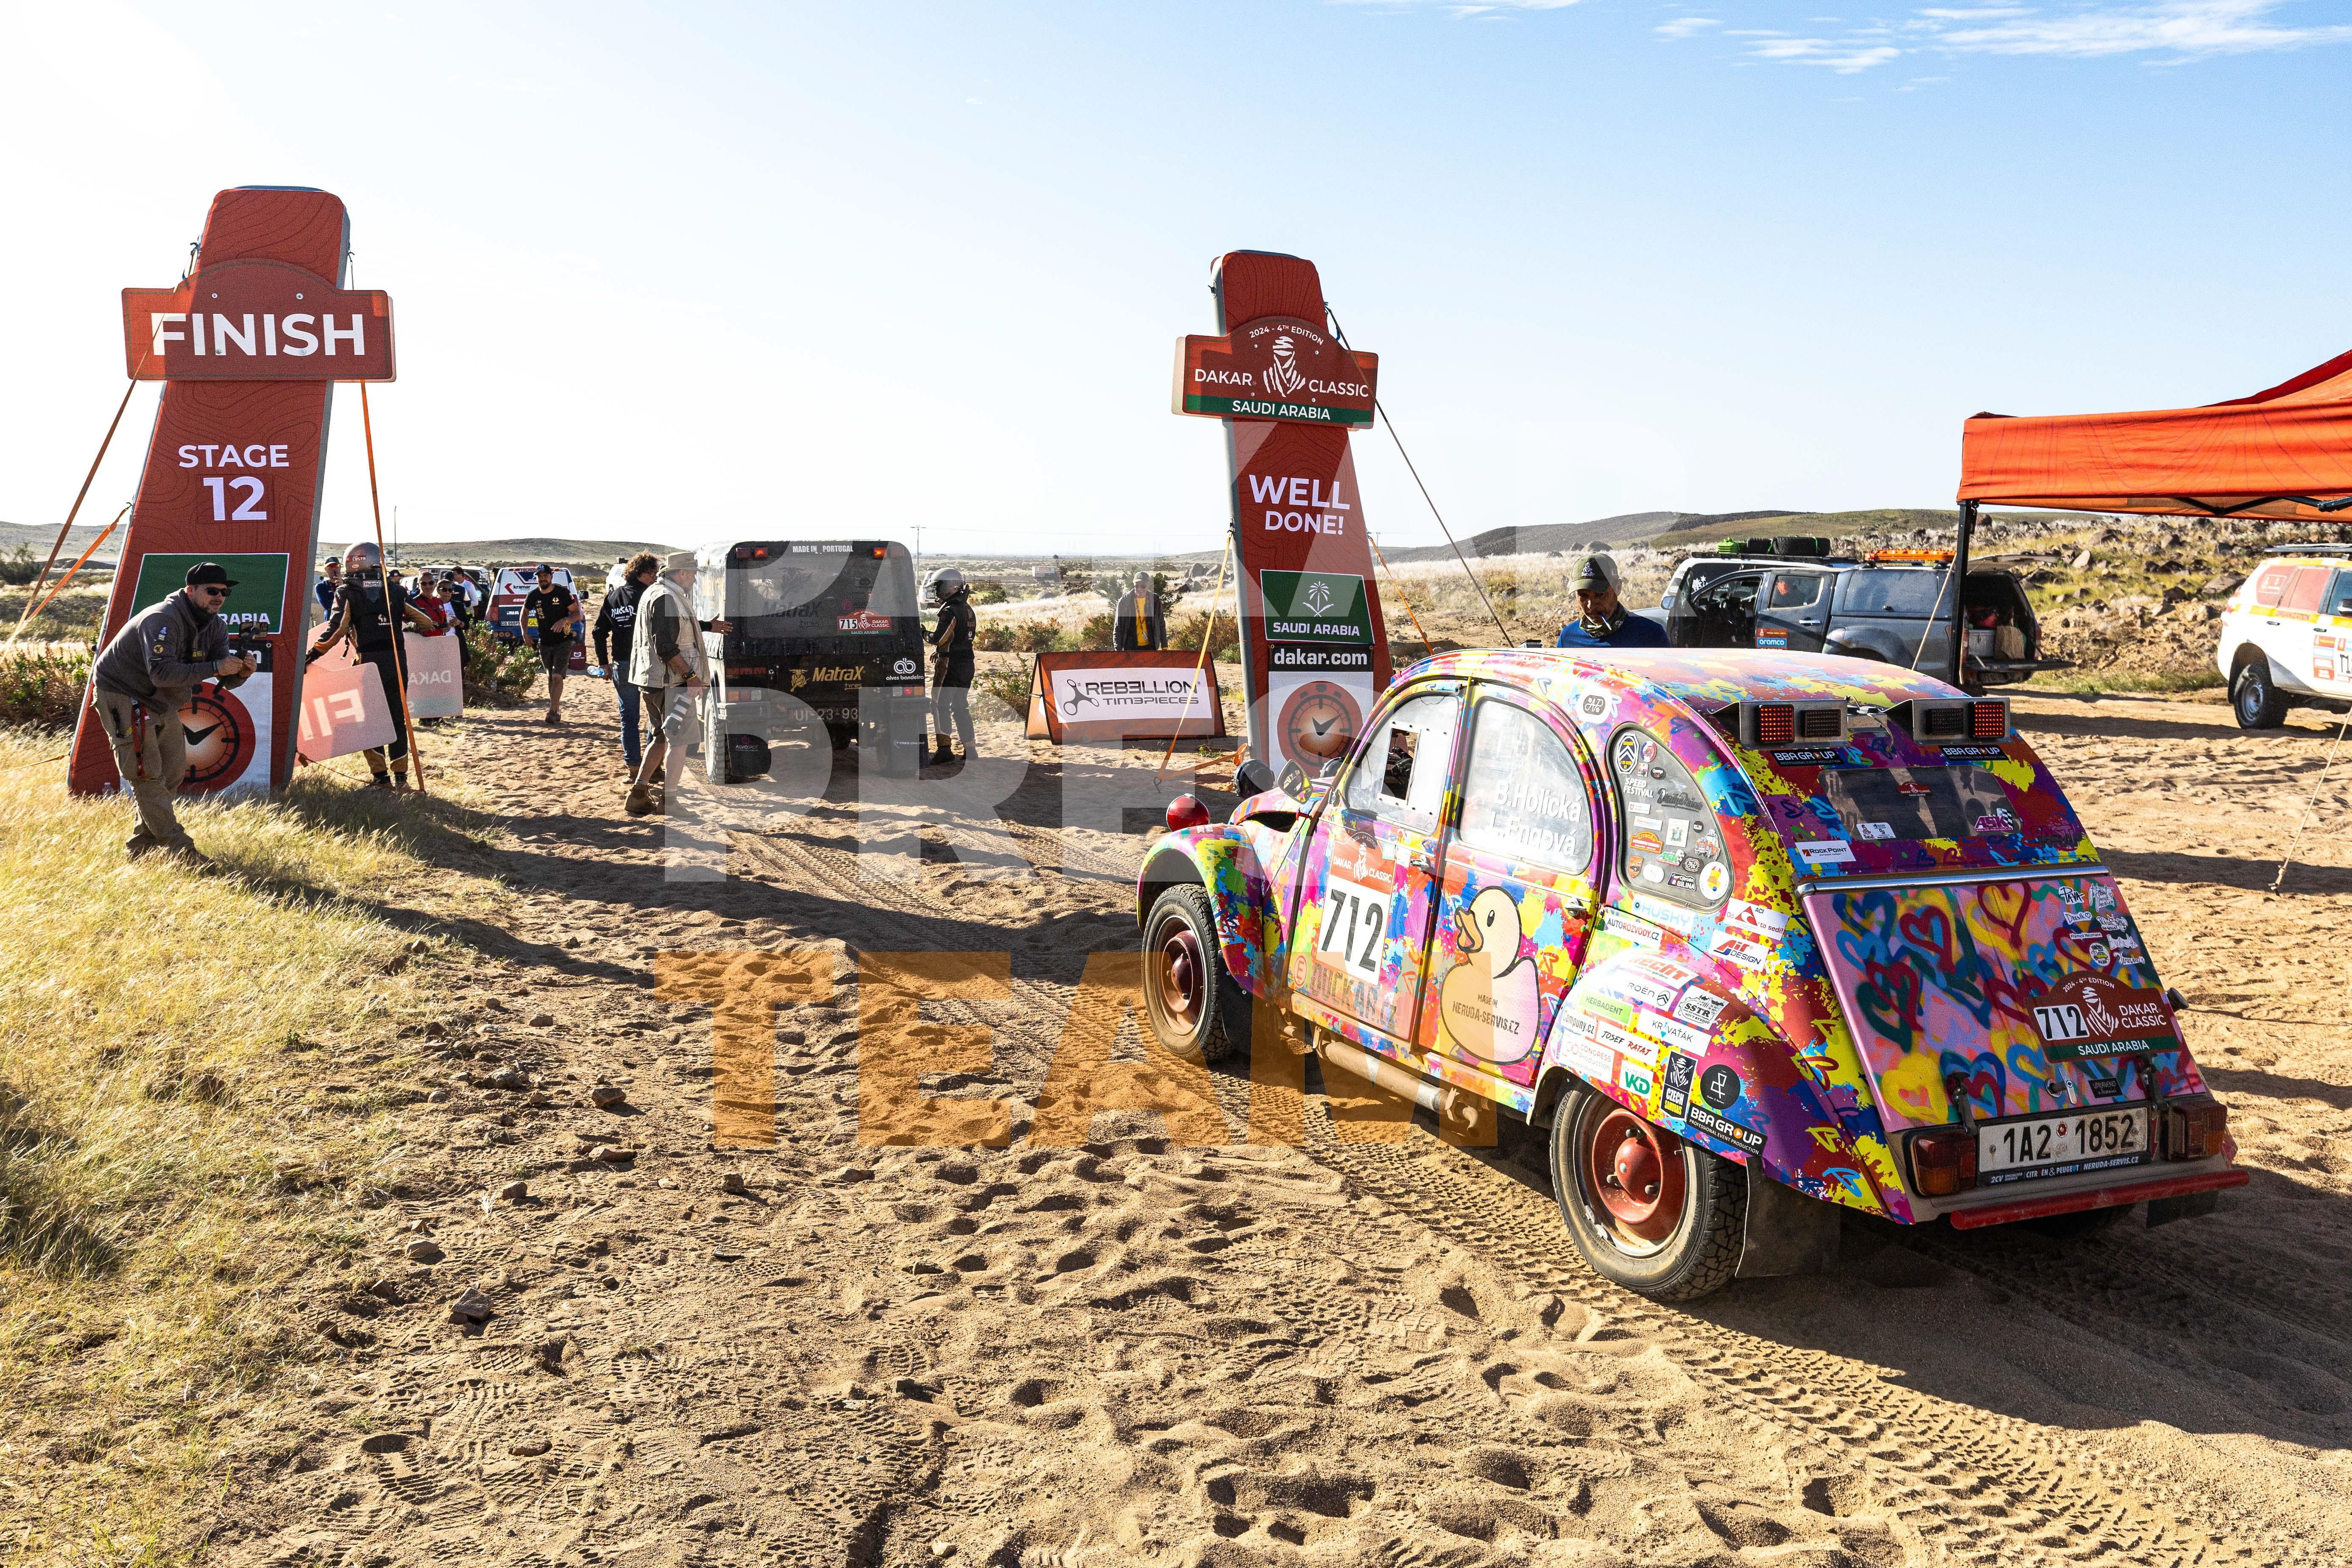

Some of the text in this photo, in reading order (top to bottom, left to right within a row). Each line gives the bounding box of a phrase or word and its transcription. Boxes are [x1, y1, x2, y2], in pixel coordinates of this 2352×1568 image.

[151, 312, 365, 356] FINISH
[1250, 326, 1270, 338] 2024
[1291, 326, 1324, 346] EDITION
[1194, 368, 1369, 397] DAKAR CLASSIC
[1232, 400, 1331, 421] SAUDI ARABIA
[178, 444, 289, 468] STAGE
[203, 476, 267, 521] 12
[1249, 474, 1350, 510] WELL
[1265, 511, 1344, 536] DONE!
[217, 613, 271, 625] RABIA
[840, 619, 857, 629] 715
[1273, 622, 1360, 636] SAUDI ARABIA
[1274, 648, 1368, 665] dakar.com
[812, 666, 865, 682] MatraX
[1623, 785, 1654, 798] FESTIVAL
[1624, 777, 1647, 788] SPEED
[1495, 779, 1582, 823] B.Holická
[1975, 816, 2009, 829] ASK
[1638, 834, 1656, 842] CITROËN
[1333, 856, 1393, 883] DAKAR CLASSIC
[1677, 880, 1695, 890] BÍLINA
[1641, 901, 1690, 926] HUSKY
[1321, 889, 1384, 972] 712
[1607, 918, 1660, 940] AUTOROZVODY.CZ
[1730, 949, 1761, 965] DESIGN
[1652, 971, 1668, 979] garden
[2062, 981, 2076, 993] 2024
[2088, 977, 2115, 989] EDITION
[1478, 994, 1498, 1008] MADE IN
[1585, 996, 1623, 1016] HERBADENT
[2118, 1003, 2159, 1016] DAKAR
[1452, 1001, 1520, 1035] NERUDA-SERVIS.CZ
[2037, 1006, 2089, 1040] 712
[2121, 1015, 2167, 1029] CLASSIC
[1601, 1031, 1652, 1055] JOSEF RATAJ
[2078, 1040, 2150, 1055] SAUDI ARABIA
[1579, 1053, 1610, 1071] Production
[1580, 1044, 1612, 1063] CONGRESS
[1666, 1087, 1684, 1106] CZECH
[1664, 1100, 1682, 1116] SAMURAIS
[1690, 1106, 1715, 1127] BBA
[1689, 1119, 1759, 1155] PROFESSIONAL EVENT PRODUCTION
[2003, 1124, 2051, 1163] 1A2
[2075, 1114, 2134, 1155] 1852
[2049, 1167, 2056, 1177] &
[2083, 1156, 2139, 1171] NERUDA-SERVIS.CZ
[1991, 1175, 2004, 1183] 2CV
